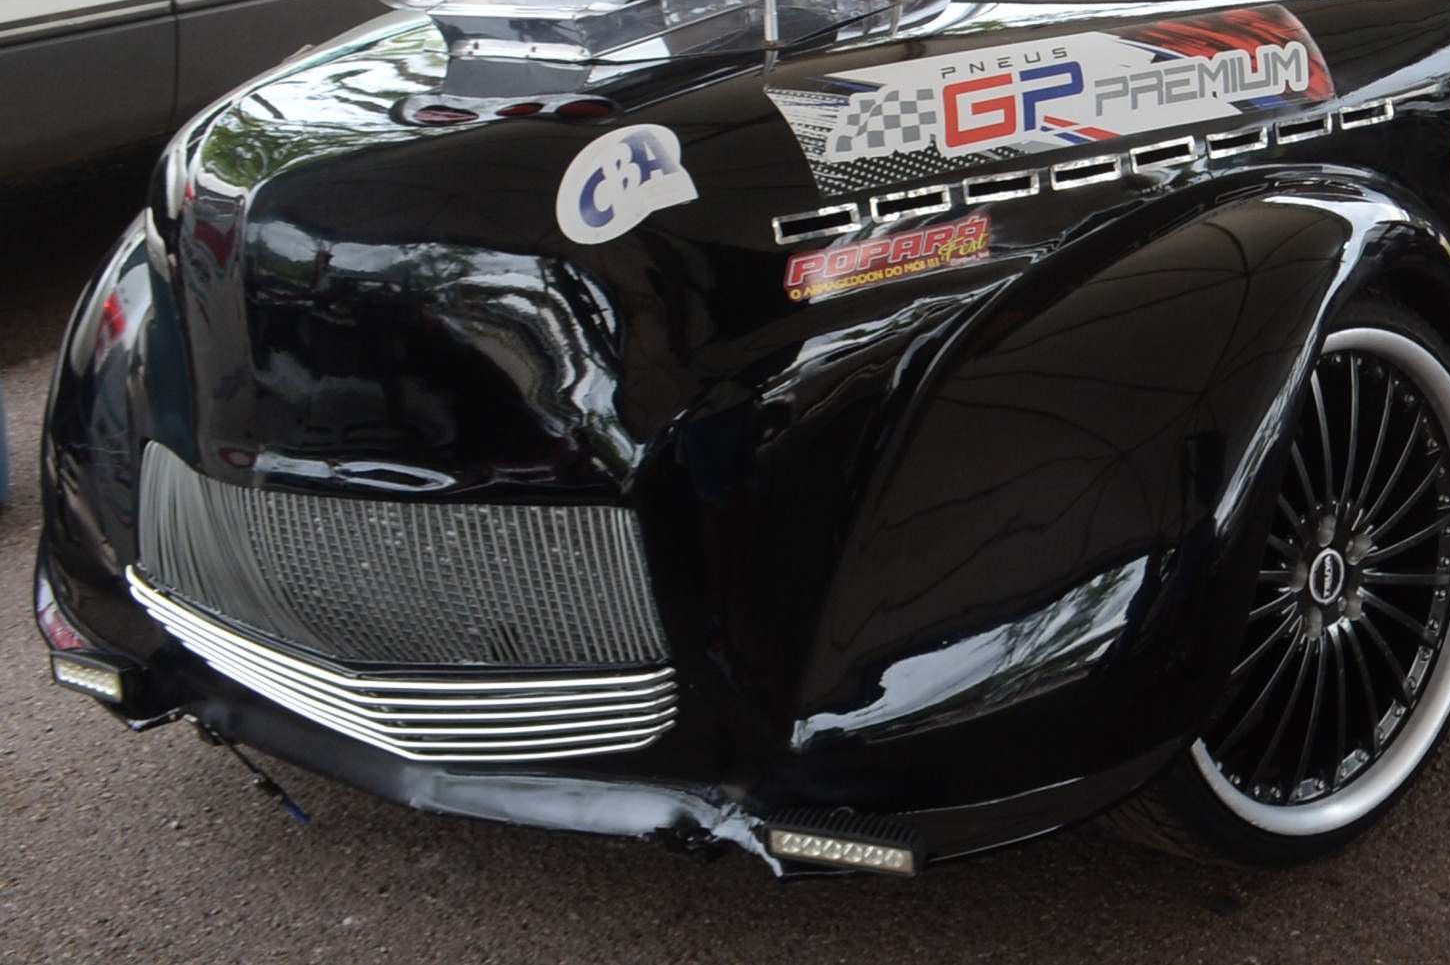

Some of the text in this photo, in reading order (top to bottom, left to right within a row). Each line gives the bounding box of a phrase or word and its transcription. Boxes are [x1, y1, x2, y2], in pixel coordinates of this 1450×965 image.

[941, 47, 1069, 80] PNEUS
[943, 47, 1302, 149] GP PREMIUM
[885, 265, 902, 278] DO
